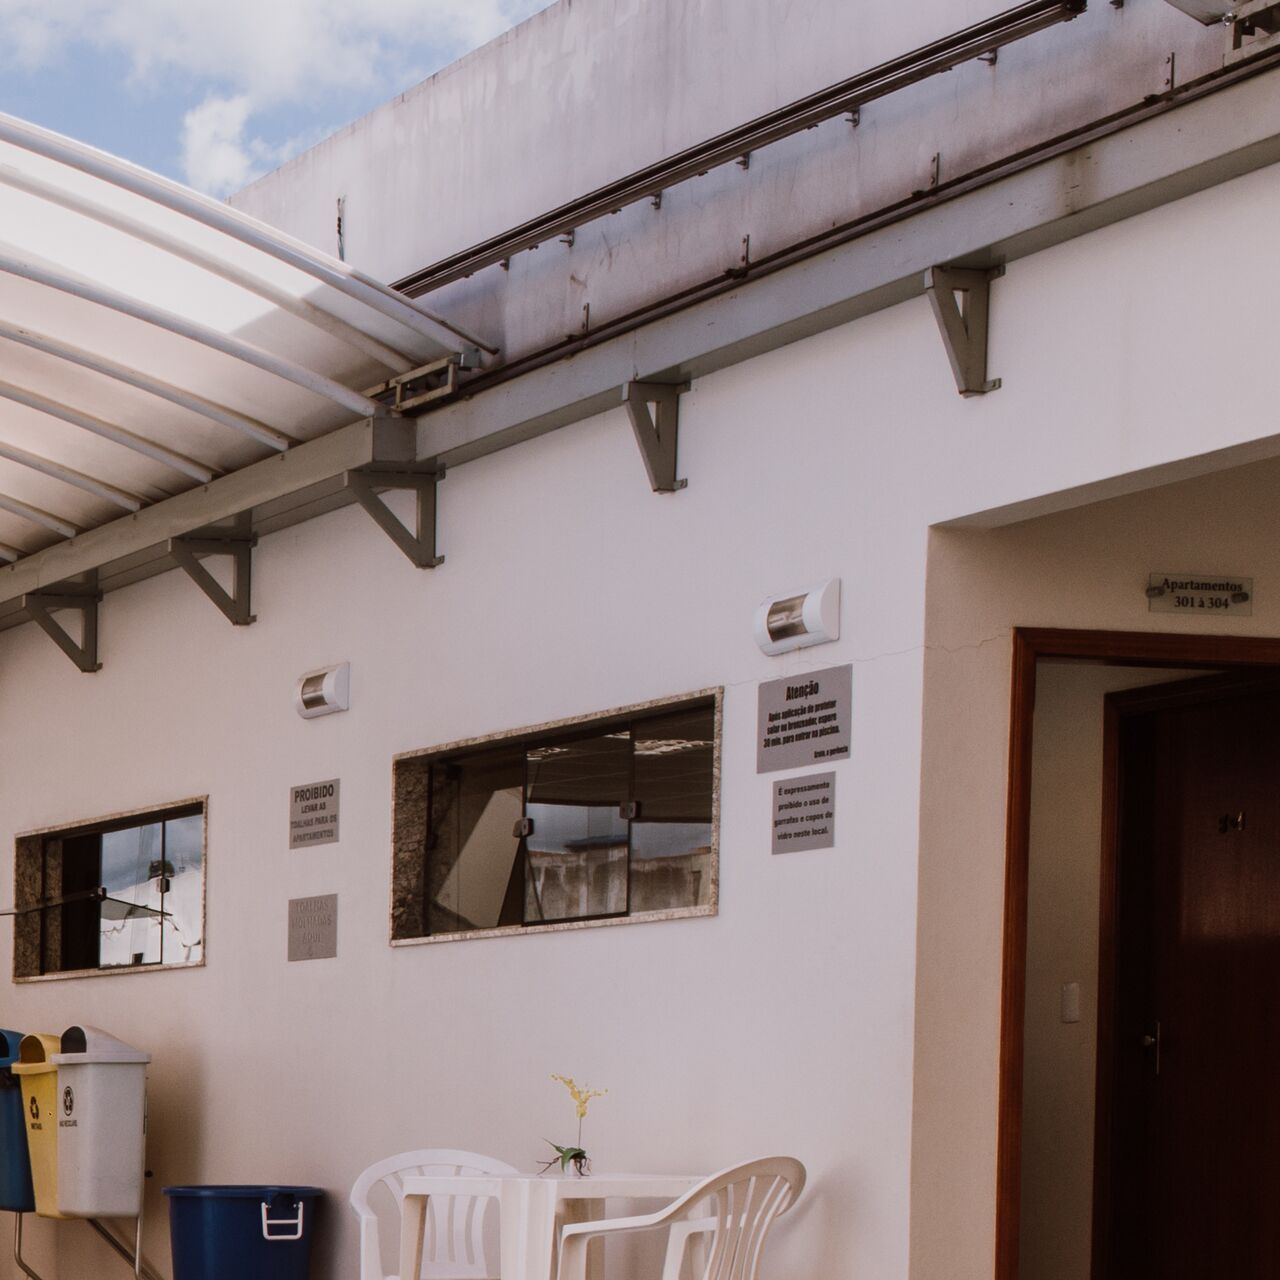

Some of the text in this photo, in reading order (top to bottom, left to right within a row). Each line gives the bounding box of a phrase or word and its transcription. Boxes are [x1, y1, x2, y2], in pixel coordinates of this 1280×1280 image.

[1162, 578, 1243, 593] Apartamentos
[1174, 596, 1195, 608] 301
[1207, 597, 1229, 609] 304
[785, 680, 819, 701] Atenção
[294, 784, 334, 803] PROIBIDO
[783, 782, 830, 795] expressamente
[301, 801, 326, 814] LEVAR AS
[778, 800, 802, 812] proibido
[809, 798, 820, 806] uso
[774, 816, 799, 828] garrafas
[805, 813, 824, 823] copos
[777, 831, 792, 840] vidro
[793, 829, 810, 838] neste
